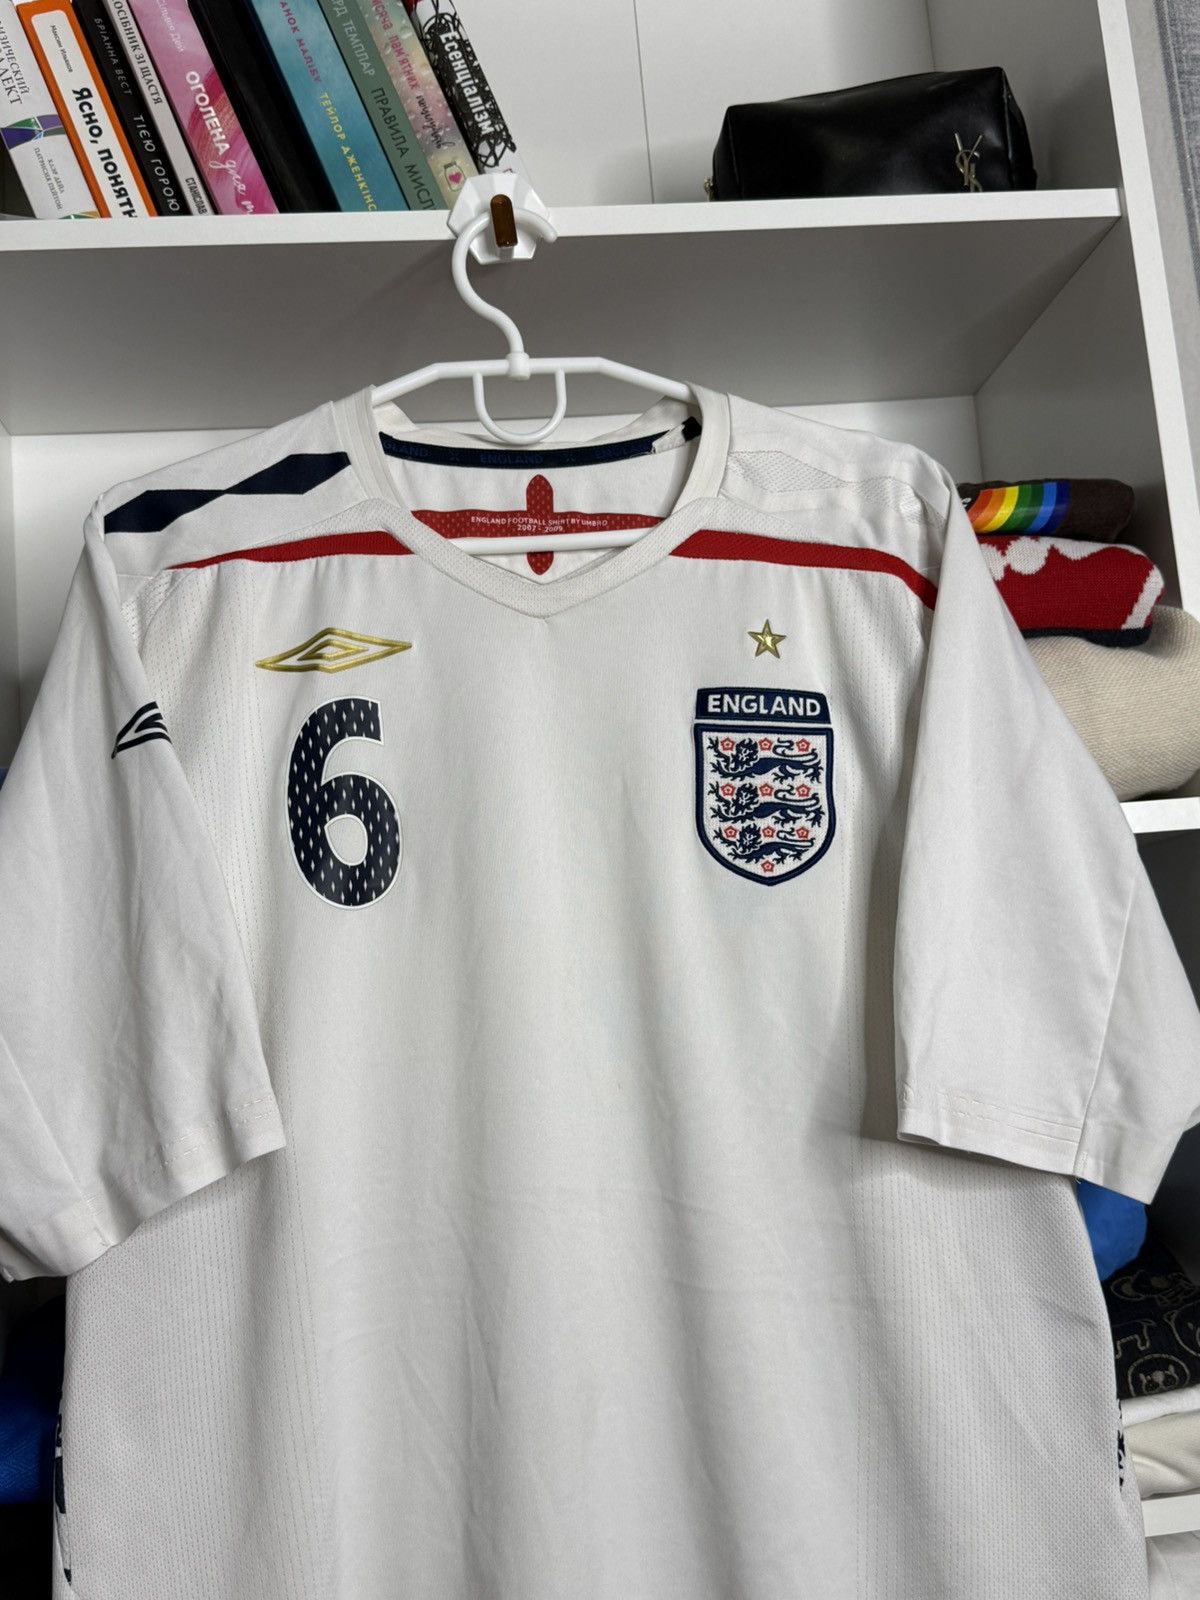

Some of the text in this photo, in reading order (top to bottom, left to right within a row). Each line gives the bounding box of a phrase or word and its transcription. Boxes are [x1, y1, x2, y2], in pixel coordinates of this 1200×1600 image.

[50, 25, 63, 47] Максим
[94, 17, 132, 95] БРІАННА ВЕСТ
[112, 0, 163, 105] ОСІБНИК ЗІ ЩАСТЯ
[296, 38, 321, 84] МАЛІБУ
[342, 19, 377, 76] ТЕМПЛАР
[440, 29, 495, 135] Есенціалізм
[72, 87, 103, 144] Ясно,
[185, 70, 231, 156] ОГОЛЕНА
[319, 92, 346, 141] ТЕЙЛОР
[133, 114, 180, 211] ТІЄЮ ГОРОЮ
[371, 86, 436, 210] ПРАВИЛА МИСЛ
[209, 159, 247, 196] для
[470, 516, 507, 526] ENGLAND
[508, 517, 547, 526] FOOTBALL
[570, 518, 580, 526] BY
[581, 519, 608, 527] UMBRO
[706, 693, 822, 718] ENGLAND
[286, 696, 402, 910] 6
